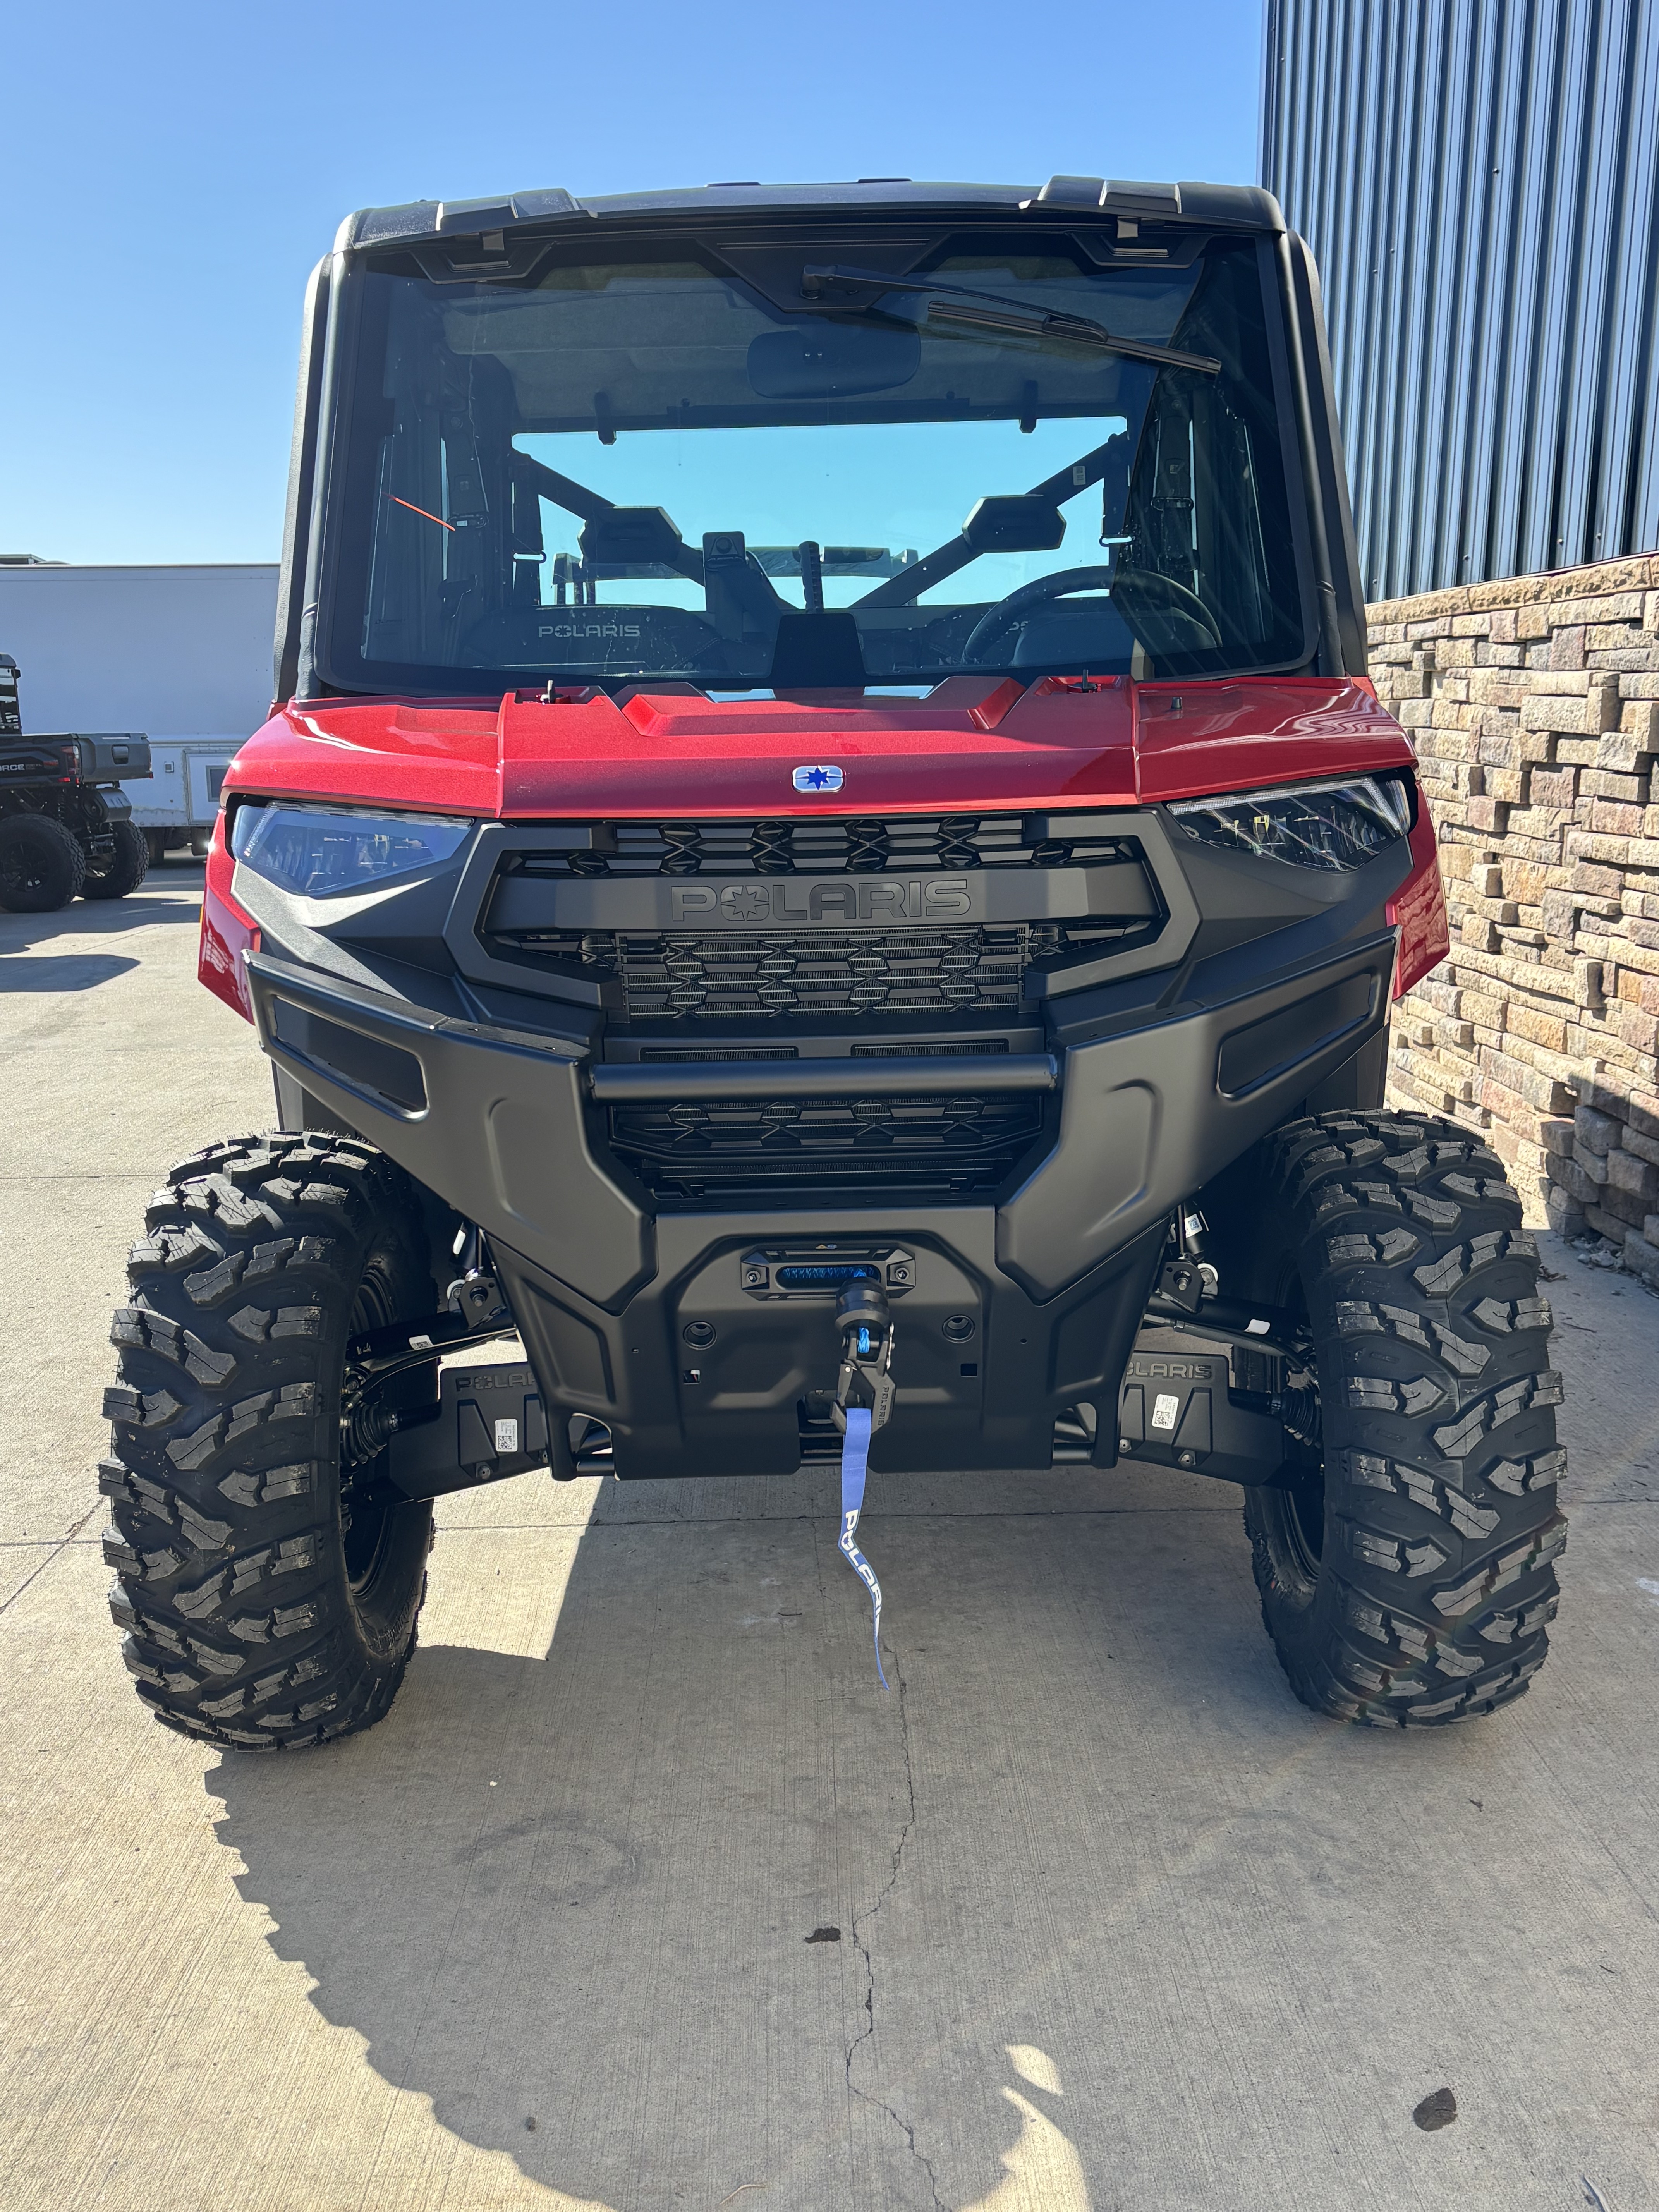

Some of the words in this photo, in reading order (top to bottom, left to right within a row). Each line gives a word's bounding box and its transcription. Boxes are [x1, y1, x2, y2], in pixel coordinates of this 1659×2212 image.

[538, 624, 641, 638] POLARIS
[671, 879, 971, 922] POLARIS
[878, 1386, 890, 1426] POLARIS
[841, 1509, 882, 1637] POLARI
